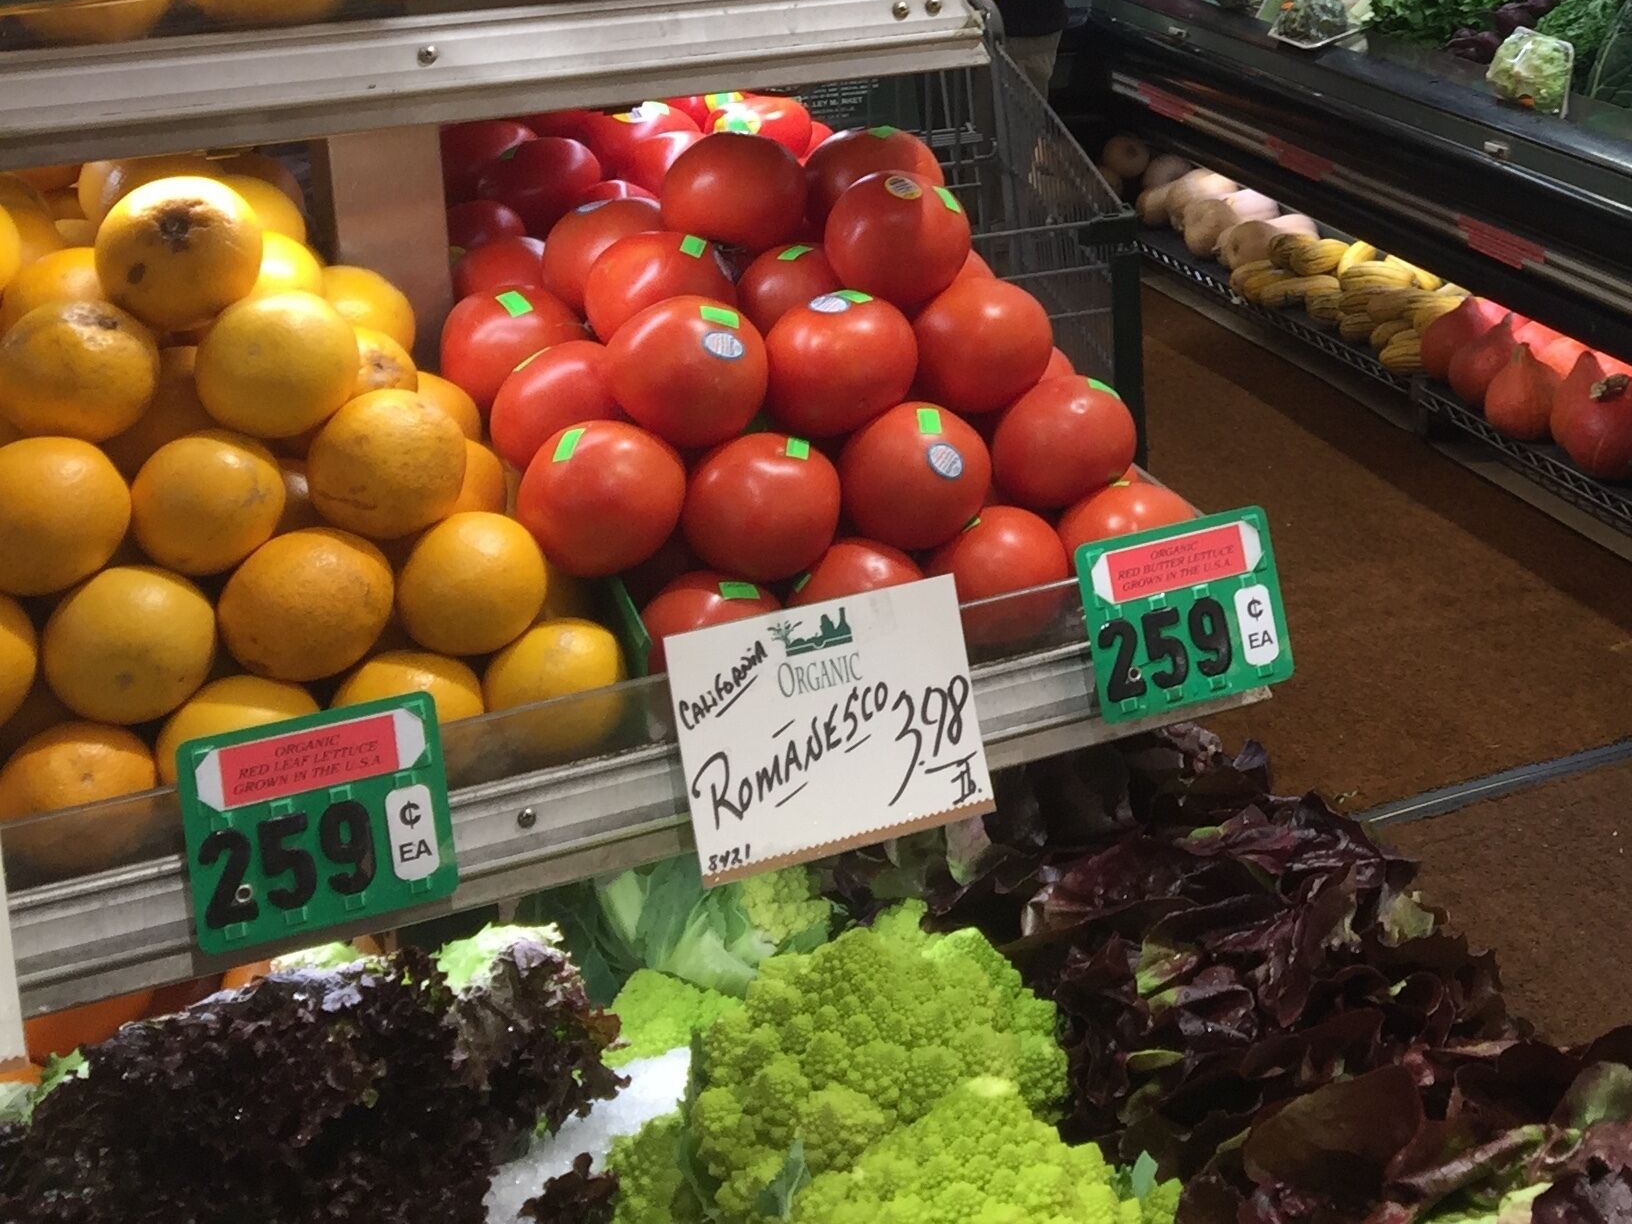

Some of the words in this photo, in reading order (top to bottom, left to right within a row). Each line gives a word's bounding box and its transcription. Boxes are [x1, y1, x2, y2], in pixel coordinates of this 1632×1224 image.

[1117, 566, 1143, 581] RED
[1143, 556, 1185, 575] BUTTER
[1186, 544, 1235, 567] LETTUCE
[1150, 540, 1199, 560] ORGANIC
[1121, 575, 1165, 592] GROWN
[1165, 572, 1178, 582] IN
[1179, 565, 1203, 580] THE
[1097, 596, 1233, 704] 259
[776, 651, 863, 698] ORGANIC
[237, 763, 271, 780] RED
[273, 754, 310, 773] LEAF
[311, 740, 379, 765] LETTUCE
[274, 733, 341, 759] ORGANIC
[232, 774, 290, 796] GROWN
[291, 769, 308, 784] IN
[310, 762, 342, 780] THE
[197, 799, 377, 930] 259
[707, 843, 751, 872] 8421
